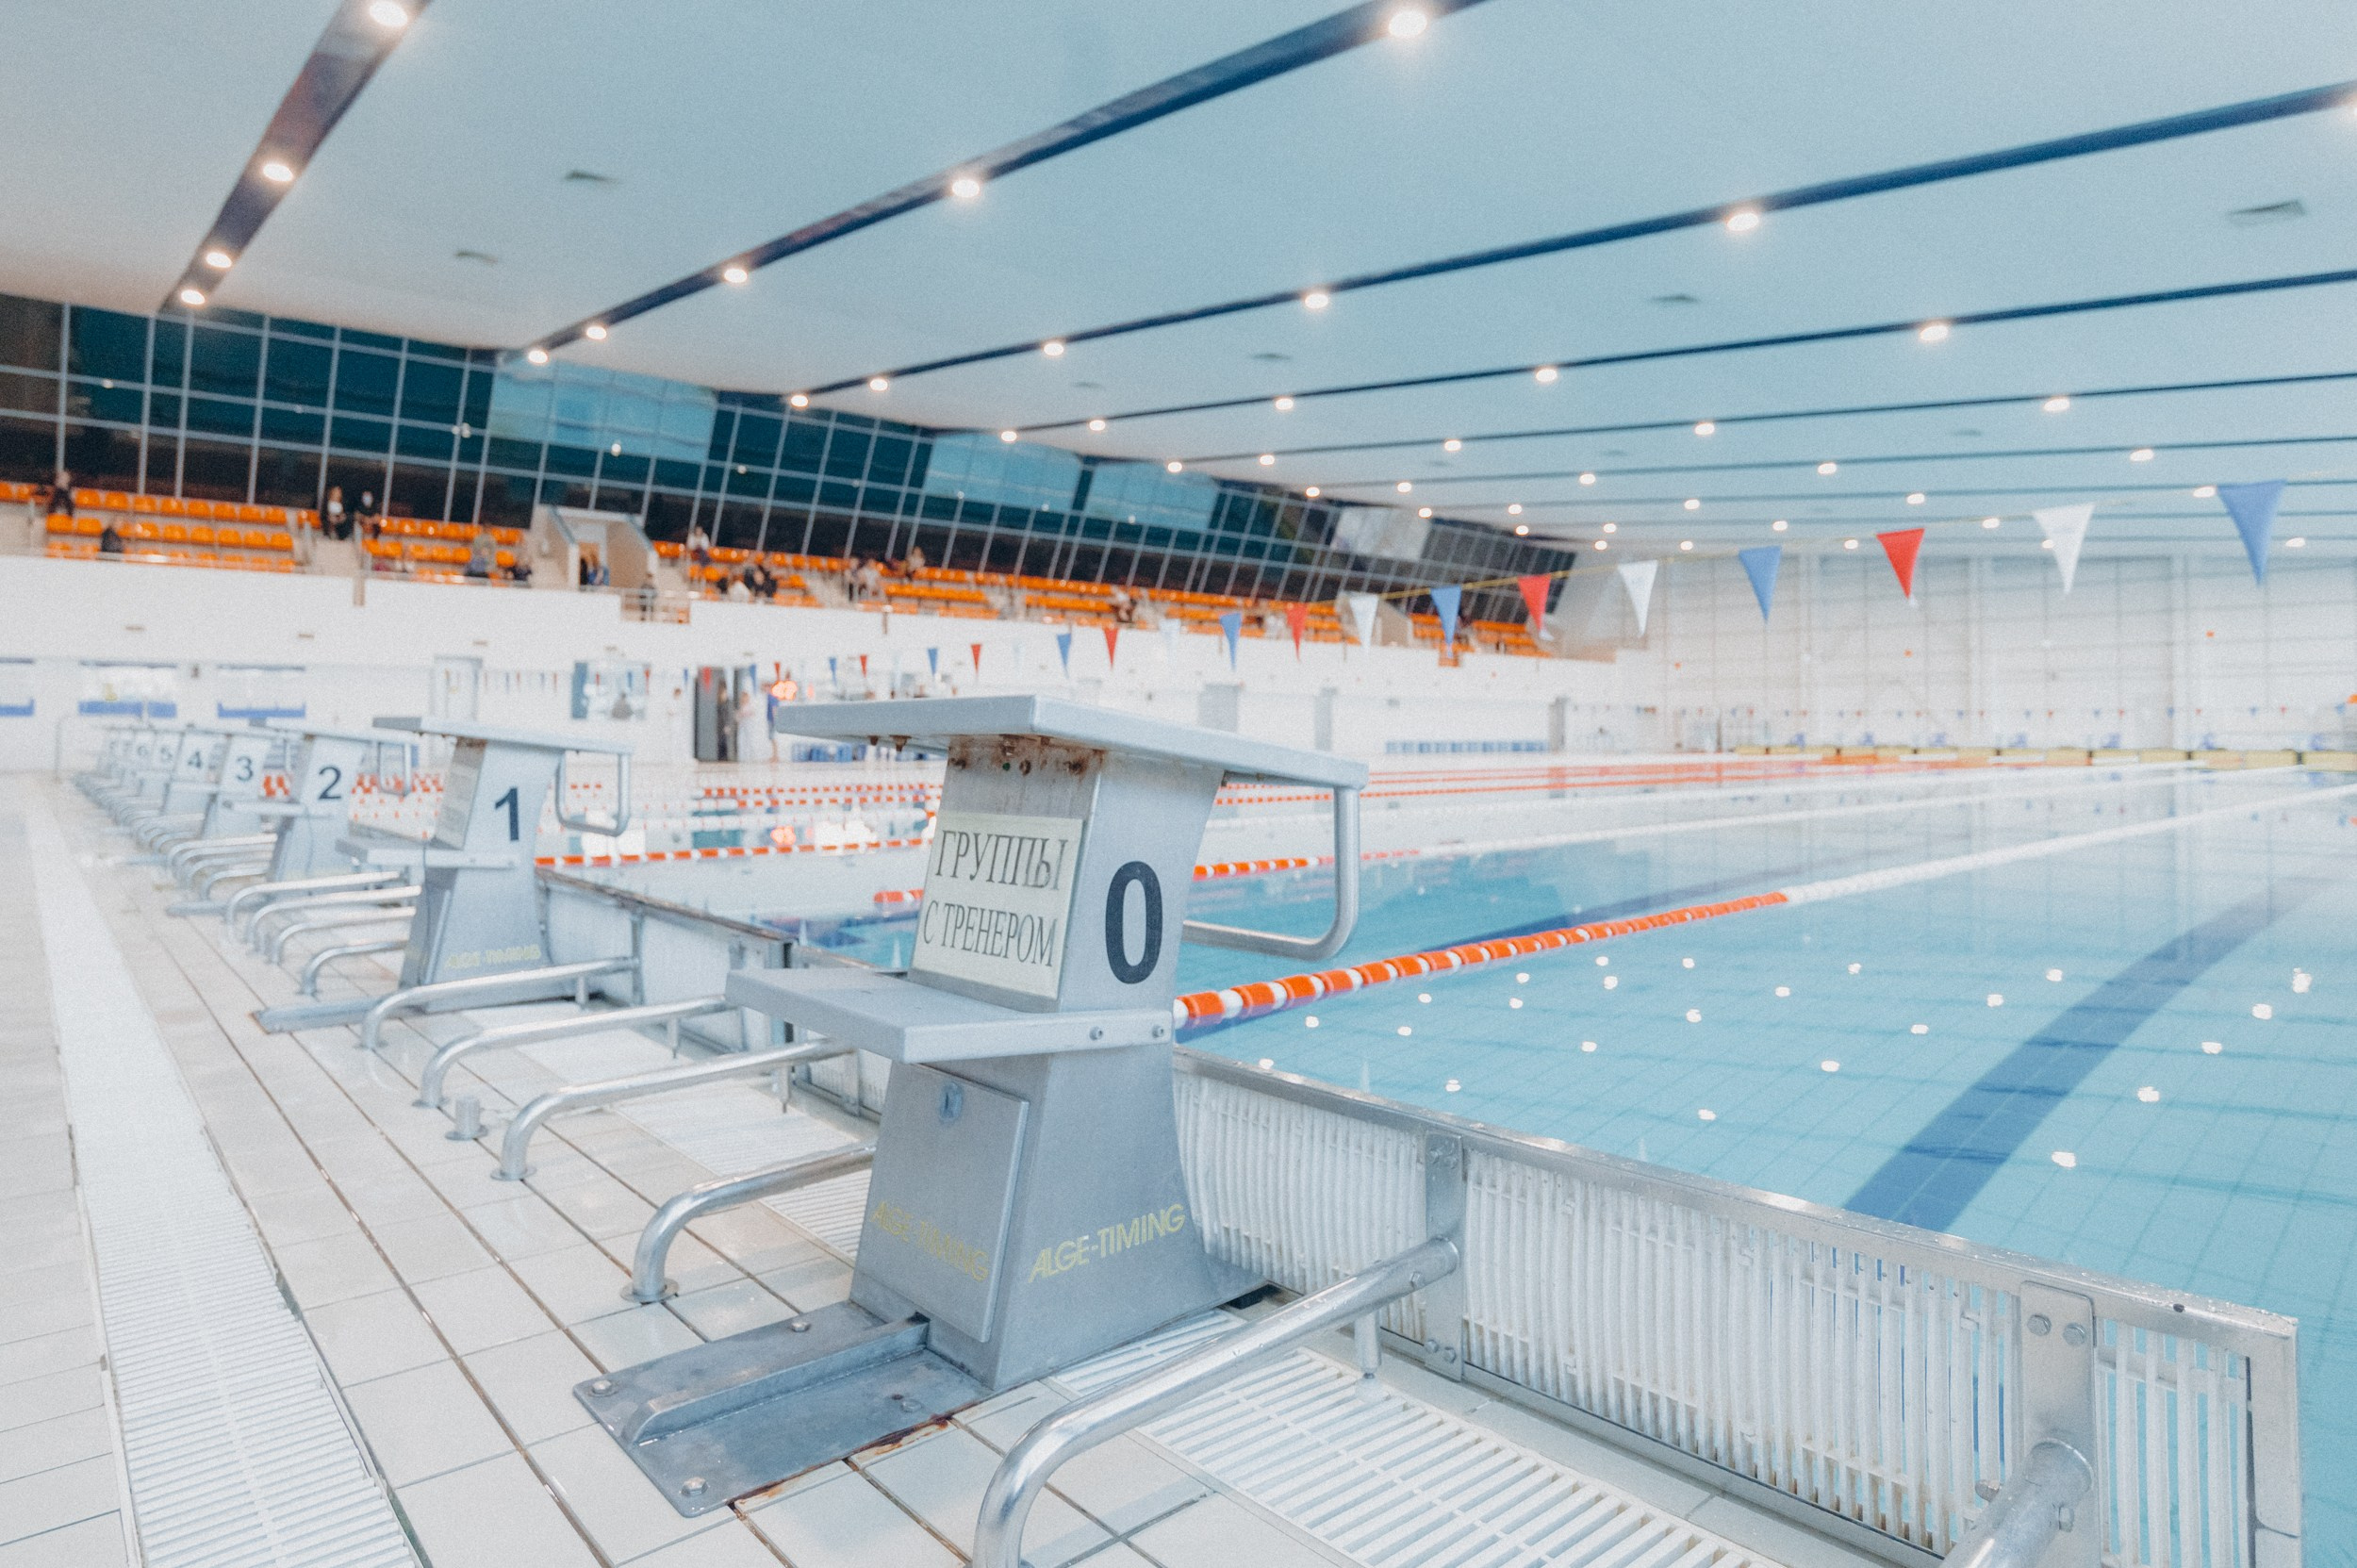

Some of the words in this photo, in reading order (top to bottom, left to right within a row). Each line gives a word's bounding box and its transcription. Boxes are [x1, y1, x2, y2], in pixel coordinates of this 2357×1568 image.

[187, 751, 202, 769] 4
[236, 756, 254, 782] 3
[318, 767, 342, 800] 2
[495, 788, 519, 840] 1
[935, 830, 1068, 891] ГРУППЫ
[923, 900, 939, 944] С
[941, 902, 1058, 967] ТРЕНЕРОМ
[1105, 861, 1163, 984] 0
[1028, 1203, 1187, 1283] ALGE-TIMING
